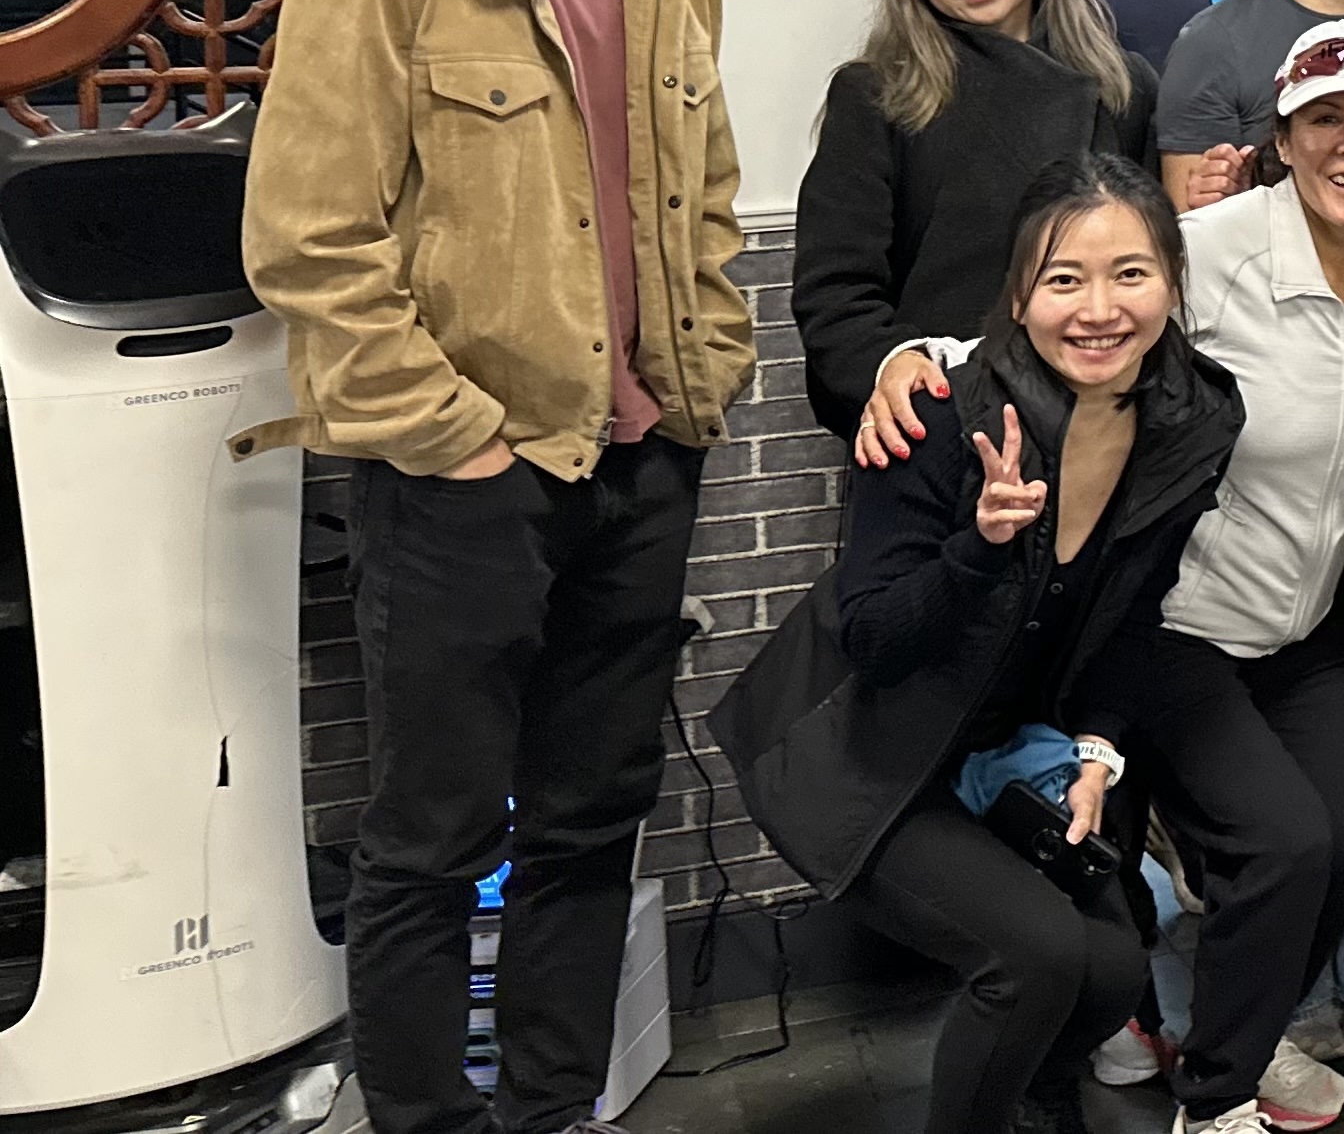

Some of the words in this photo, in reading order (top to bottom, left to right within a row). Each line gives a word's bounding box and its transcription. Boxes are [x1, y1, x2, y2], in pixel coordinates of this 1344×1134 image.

[124, 390, 188, 406] GREENCO
[193, 383, 241, 397] ROBOTS
[138, 955, 202, 974] GREENCO
[206, 940, 255, 960] ROBOTS
